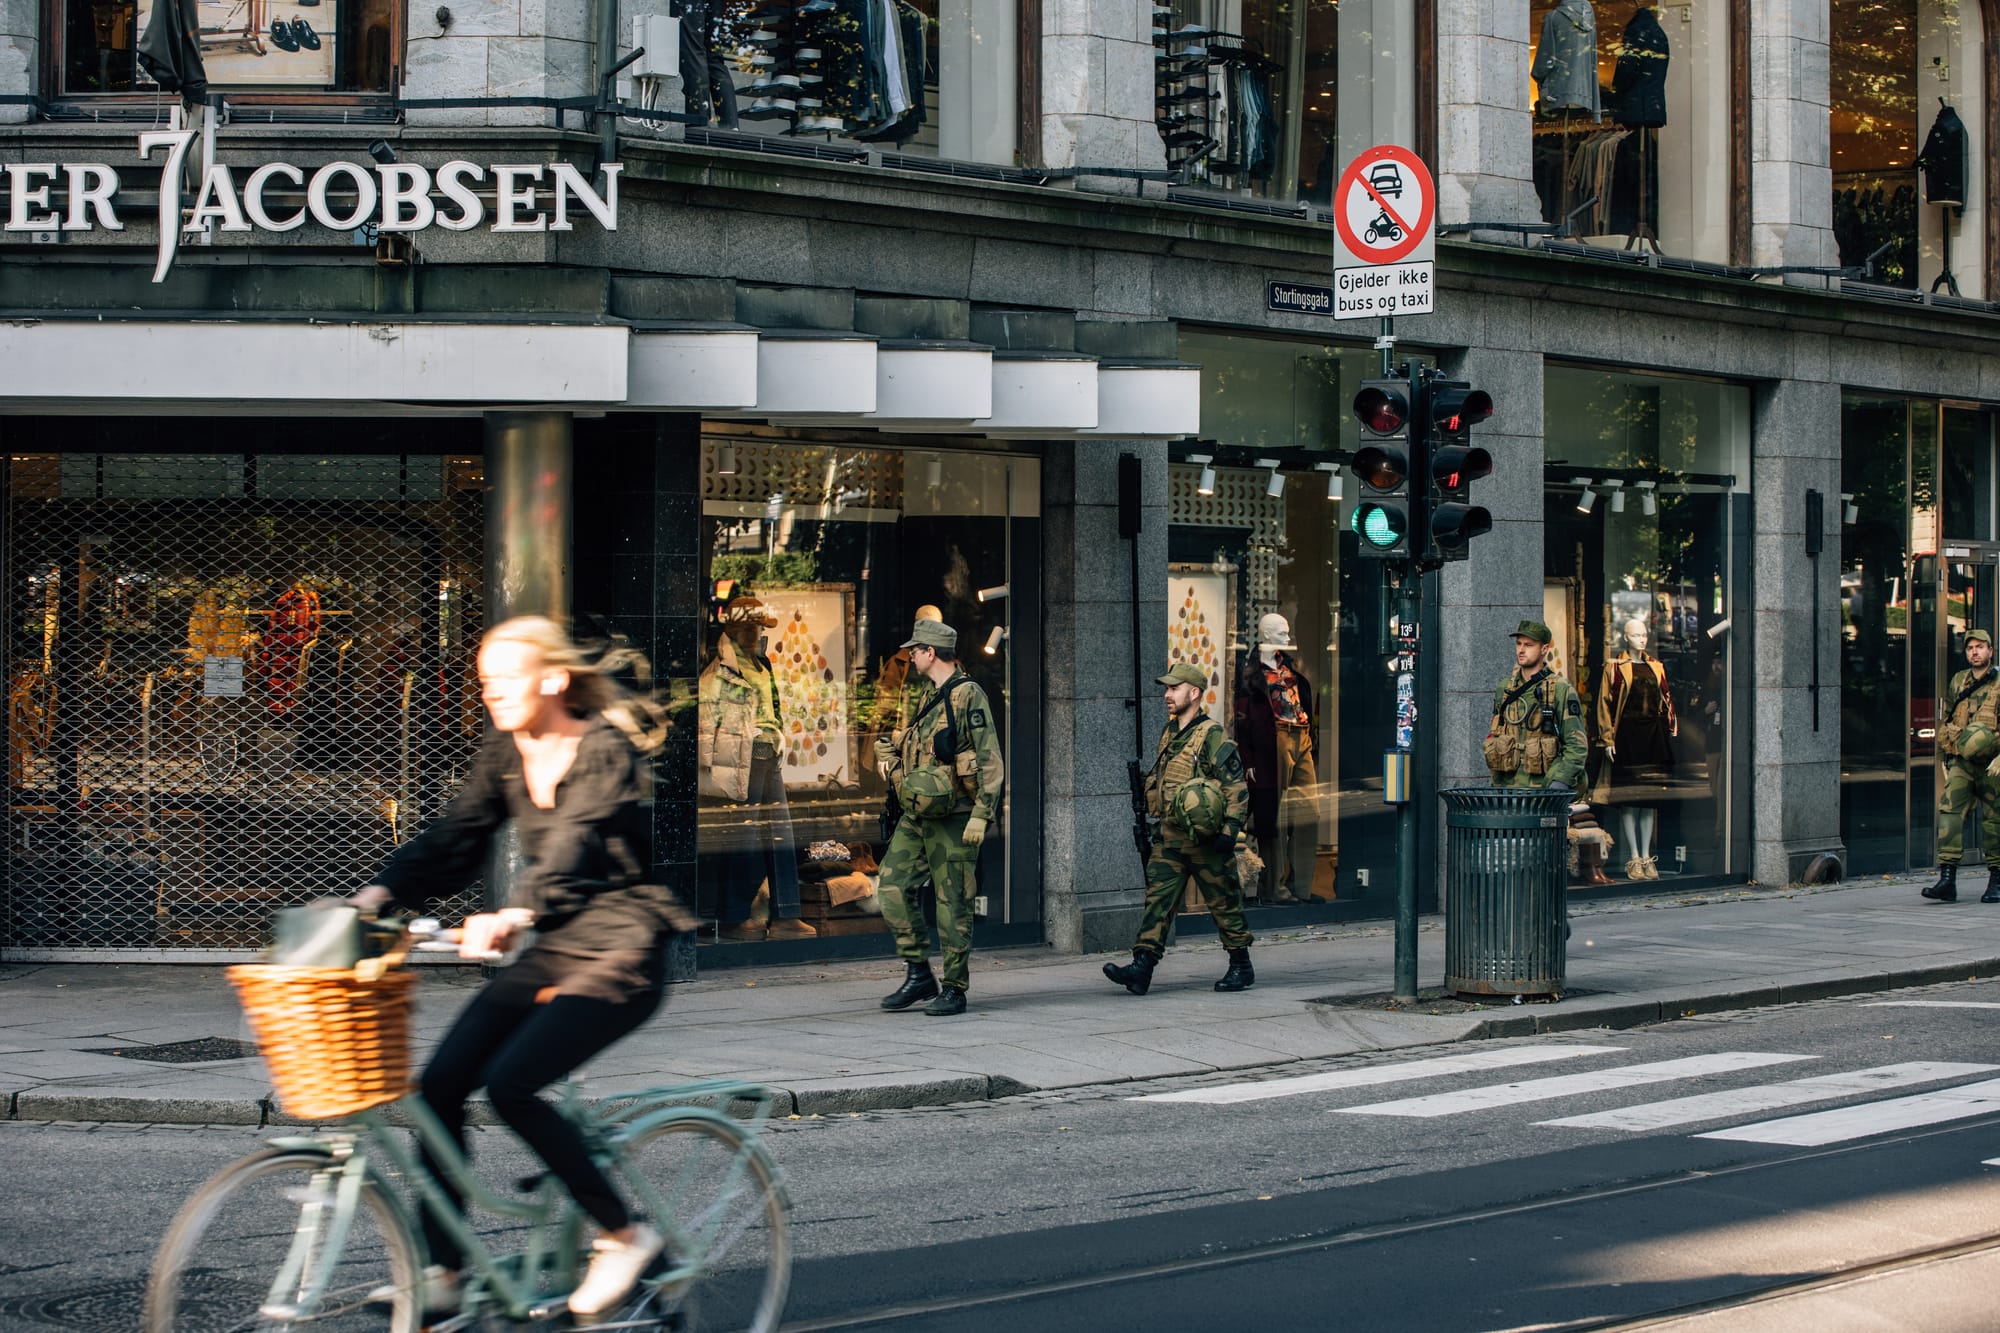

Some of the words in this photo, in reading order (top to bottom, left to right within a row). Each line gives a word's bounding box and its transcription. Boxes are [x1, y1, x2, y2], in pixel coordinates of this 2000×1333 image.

[0, 163, 124, 231] ER
[138, 129, 624, 283] JACOBSEN
[1340, 272, 1390, 293] Gjelder
[1399, 269, 1428, 285] ikke
[1274, 286, 1329, 311] Stortingsgata
[1339, 296, 1373, 311] buss
[1378, 295, 1396, 311] og
[1401, 290, 1428, 306] taxi
